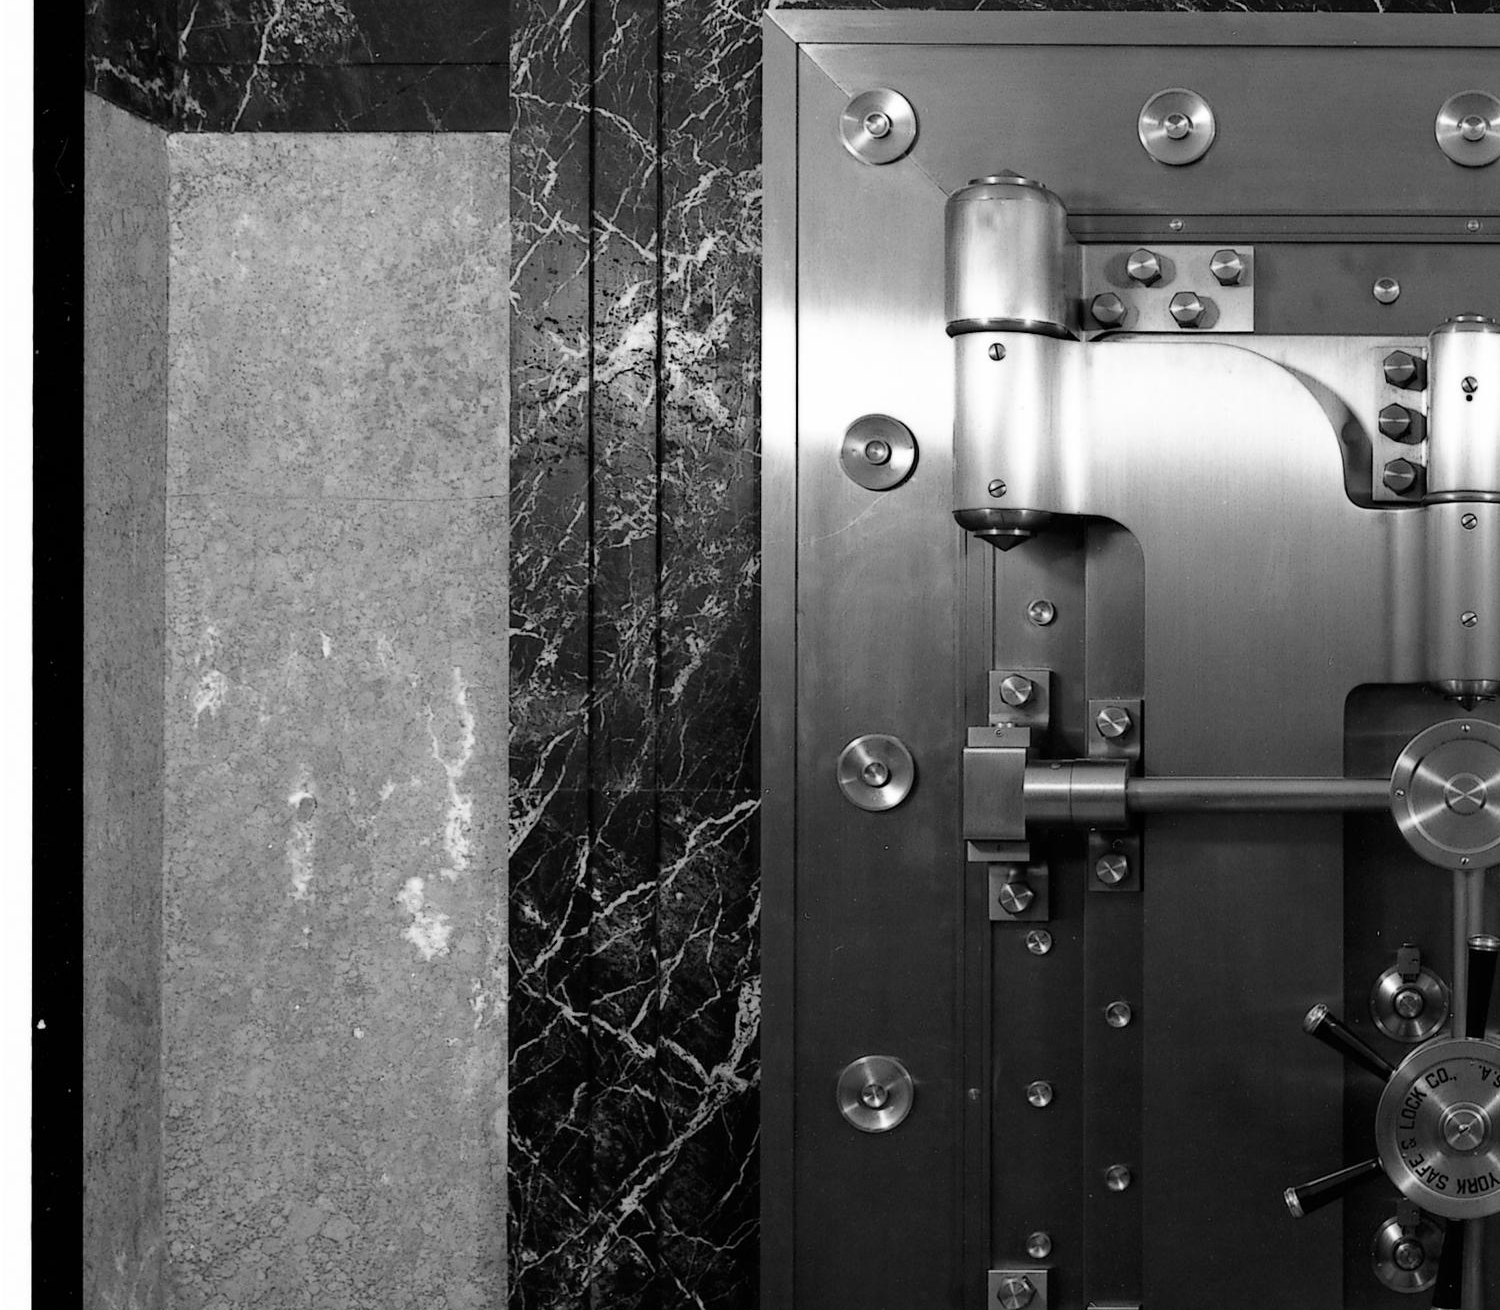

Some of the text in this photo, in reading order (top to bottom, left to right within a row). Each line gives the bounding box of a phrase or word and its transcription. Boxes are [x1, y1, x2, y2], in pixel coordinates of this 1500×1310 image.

[1400, 1087, 1427, 1130] LOCK
[1401, 1137, 1416, 1150] &
[1409, 1153, 1449, 1190] SAFE
[1457, 1172, 1500, 1194] YORK
